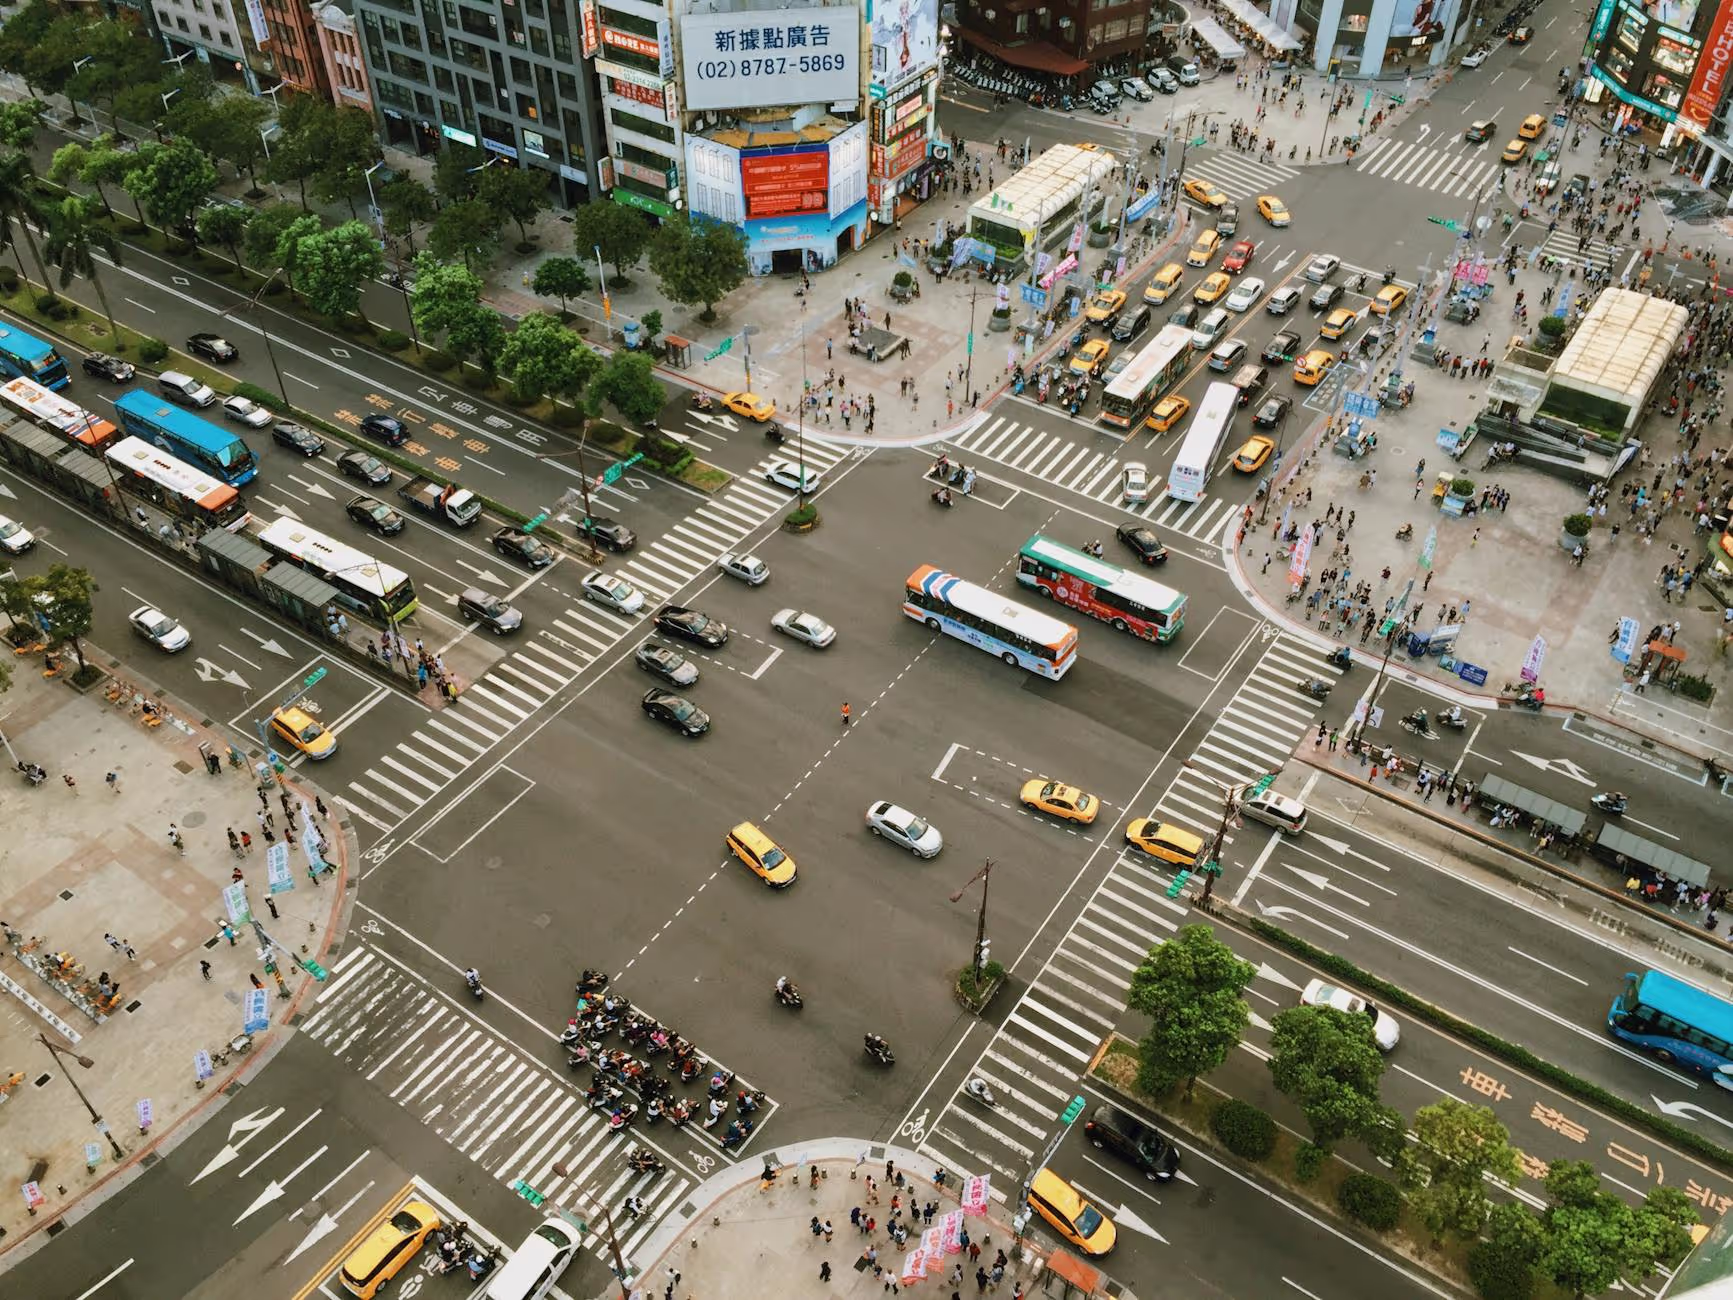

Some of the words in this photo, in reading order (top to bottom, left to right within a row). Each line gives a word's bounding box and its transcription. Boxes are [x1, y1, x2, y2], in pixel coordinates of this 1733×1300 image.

[697, 53, 845, 80] (02)8787-5869
[715, 24, 830, 52] 新據點廣告
[1702, 34, 1733, 96] HOTEL
[333, 408, 463, 473] 禁機車
[417, 385, 549, 447] 公車專用
